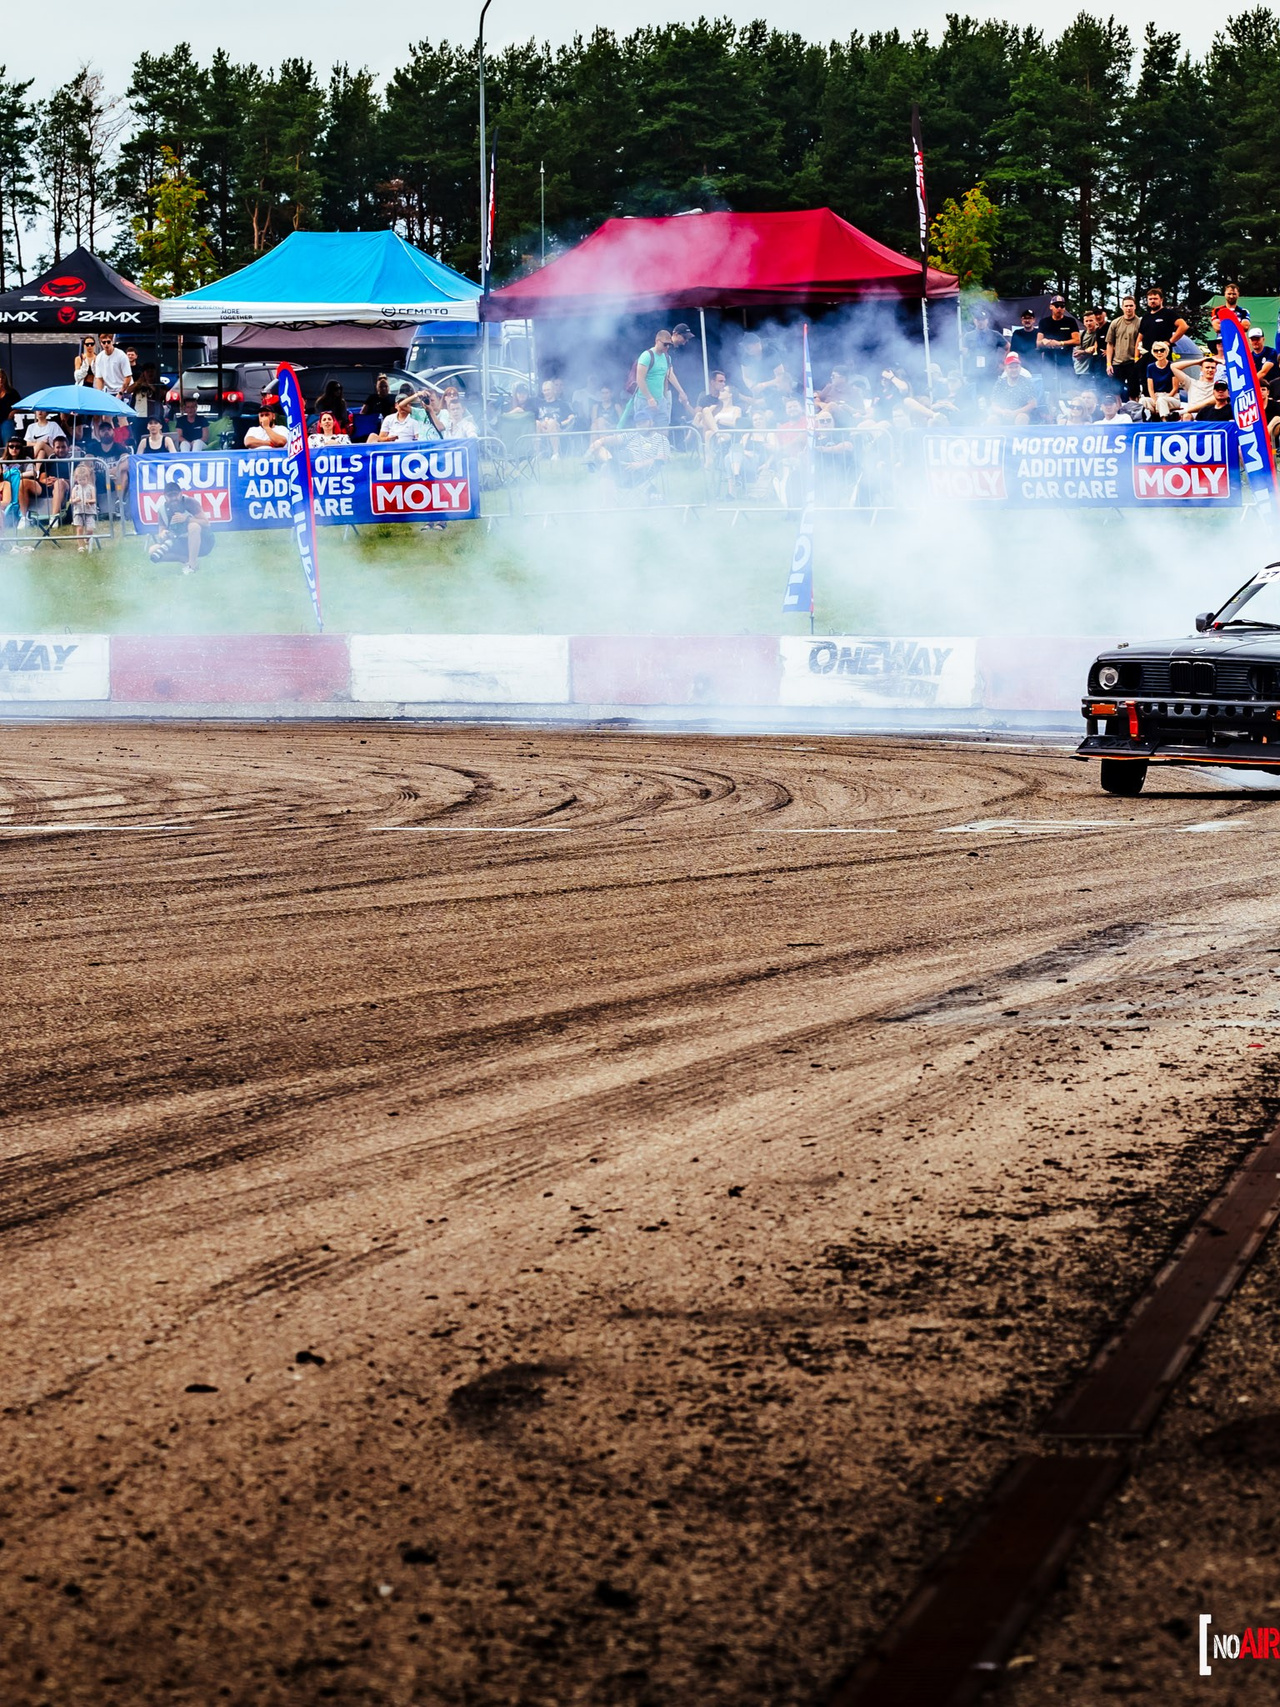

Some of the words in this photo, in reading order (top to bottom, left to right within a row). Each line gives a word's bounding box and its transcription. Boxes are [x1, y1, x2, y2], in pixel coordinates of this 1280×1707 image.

[77, 311, 141, 323] 24MX
[926, 437, 1000, 466] LIQUI
[1012, 436, 1080, 455] MOTOR
[1082, 435, 1127, 454] OILS
[1138, 434, 1222, 466] LIQUI
[142, 461, 225, 490] LIQUI
[315, 454, 363, 474] OILS
[376, 451, 463, 481] LIQUI
[1017, 458, 1118, 478] ADDITIVES
[1021, 481, 1061, 499] CAR
[1064, 480, 1118, 499] CARE
[1138, 466, 1226, 497] MOLY
[376, 481, 467, 511] MOLY
[249, 501, 291, 520] CAR
[313, 498, 354, 516] ARE
